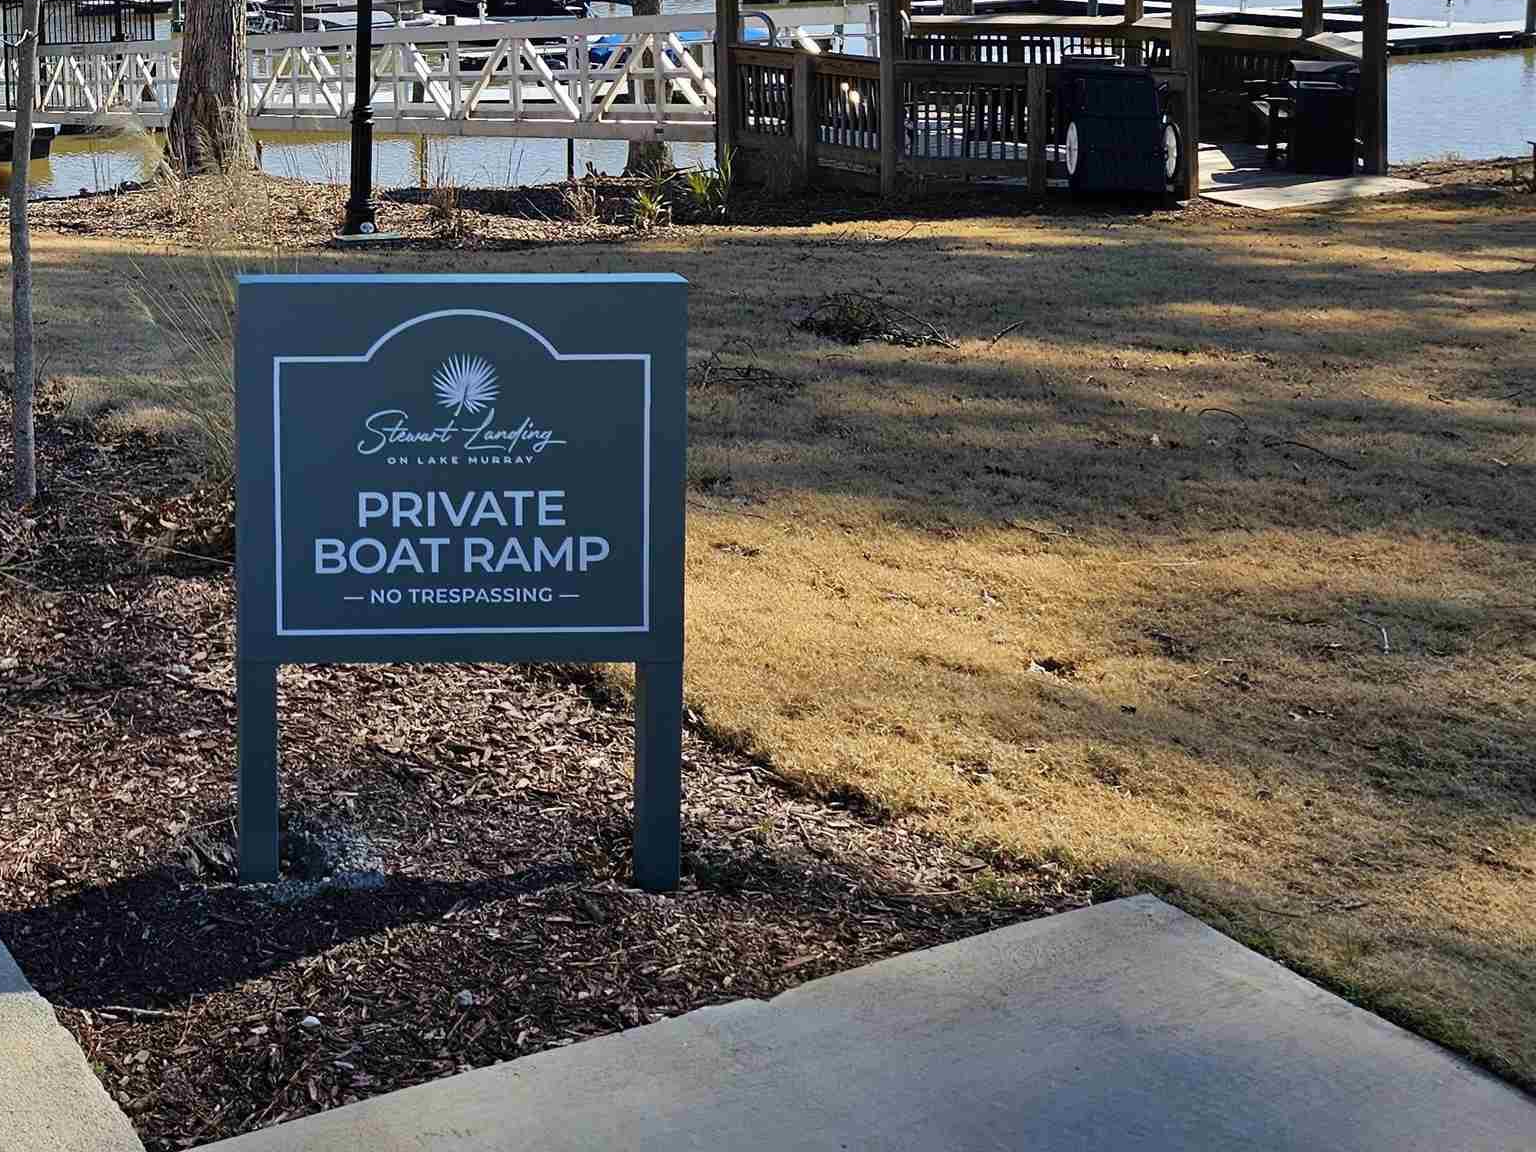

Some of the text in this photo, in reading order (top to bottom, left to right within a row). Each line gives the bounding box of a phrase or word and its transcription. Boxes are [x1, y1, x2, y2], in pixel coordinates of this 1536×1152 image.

[358, 408, 567, 455] Stewart Landing
[387, 455, 535, 465] ON LAKE MURRAY
[358, 490, 566, 528] PRIVATE
[314, 535, 610, 574] BOAT RAMP
[370, 587, 553, 604] NO TRESPASSING
